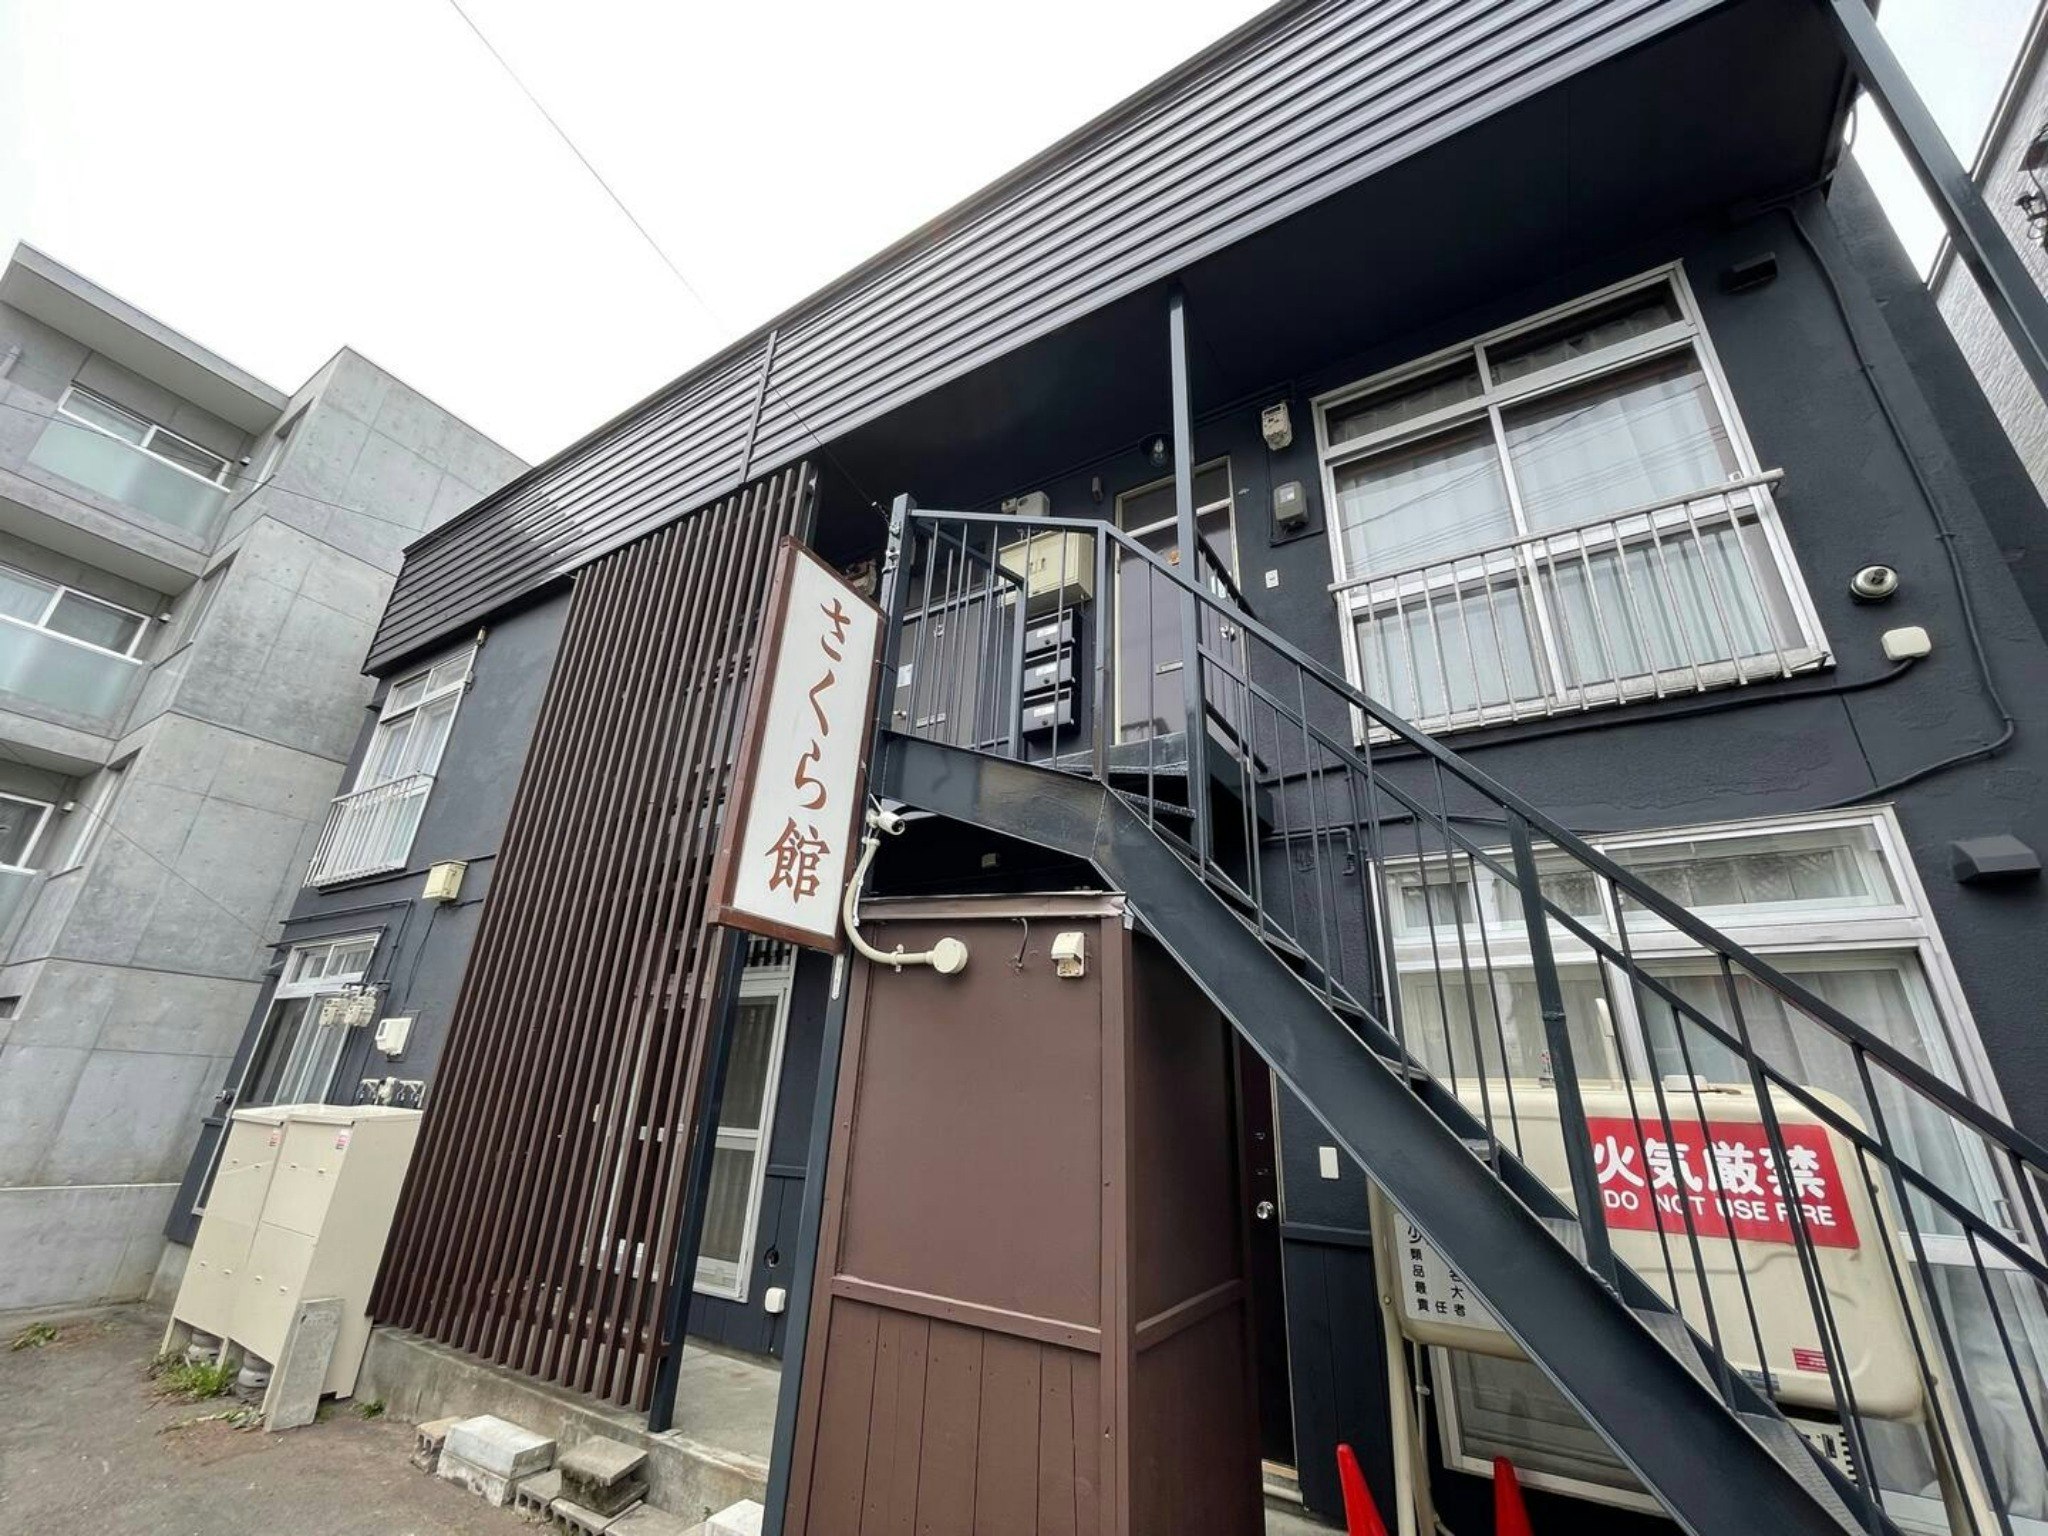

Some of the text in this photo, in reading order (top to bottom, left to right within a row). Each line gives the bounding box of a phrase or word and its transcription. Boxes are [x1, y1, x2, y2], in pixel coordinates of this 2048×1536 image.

[765, 597, 851, 904] さくら館
[1594, 1135, 1826, 1200] 火気厳禁
[1604, 1189, 1639, 1211] DO
[1715, 1198, 1770, 1222] USE
[1776, 1203, 1837, 1227] FRE
